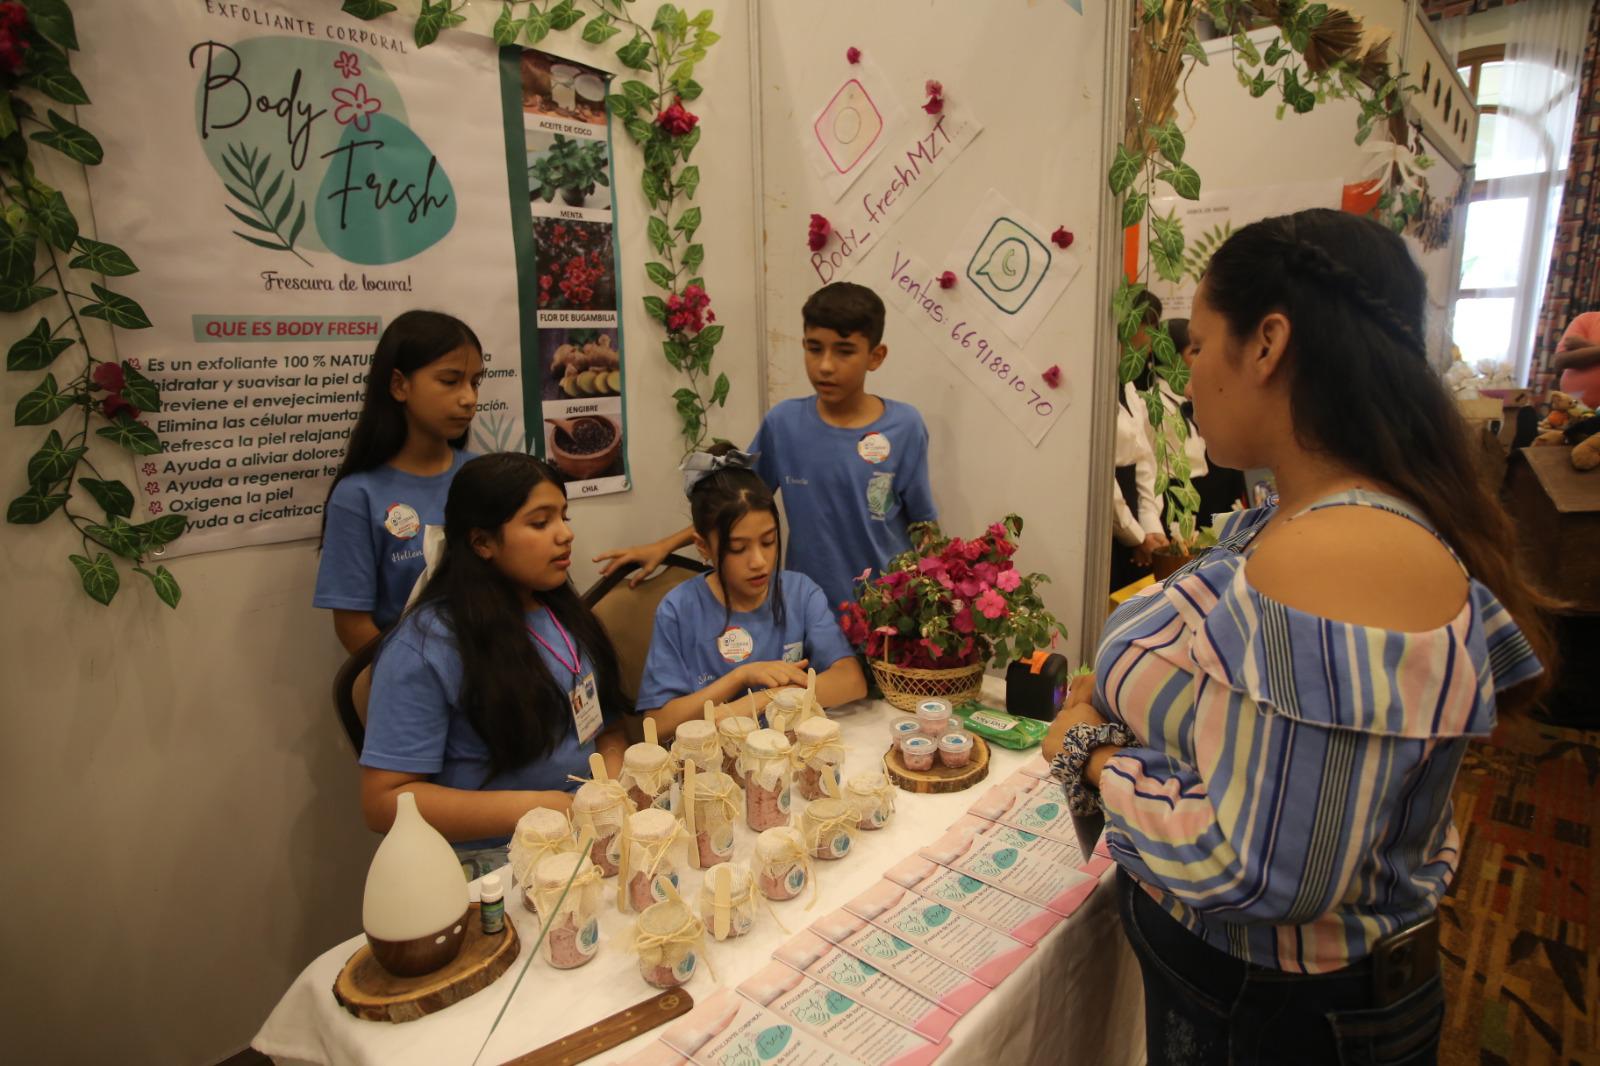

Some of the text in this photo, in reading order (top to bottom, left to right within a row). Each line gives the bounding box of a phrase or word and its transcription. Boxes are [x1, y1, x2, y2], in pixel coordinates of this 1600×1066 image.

[205, 0, 408, 54] EXFOLIANTE CORPORAL
[188, 40, 328, 171] Body
[539, 121, 592, 136] ACEITE DE COCO
[320, 140, 448, 230] Fresh
[560, 210, 583, 219] MENTA
[261, 271, 412, 292] Frescura de locura!
[540, 313, 616, 322] FLOR DE BUGAMBILIA
[206, 320, 378, 339] QUE ES BODY FRESH
[148, 353, 376, 372] Es un exfoliante 100 % NATUR
[223, 378, 233, 392] y
[237, 374, 301, 389] suavisar
[304, 373, 318, 387] la
[322, 371, 348, 388] piel
[233, 396, 247, 408] el
[252, 390, 367, 409] envejecimiento
[566, 404, 599, 414] JENGIBRE
[157, 409, 361, 434] Elimina las célular muerta
[160, 427, 350, 453] Refresca la piel relajand
[163, 446, 345, 476] Ayuda a aliviar dolores
[166, 476, 223, 494] Ayuda
[228, 475, 239, 487] a
[243, 467, 319, 486] regenerar
[581, 485, 598, 494] CHIA
[169, 487, 293, 514] Oxigena la piel
[185, 503, 325, 534] yuda a cicatrizac
